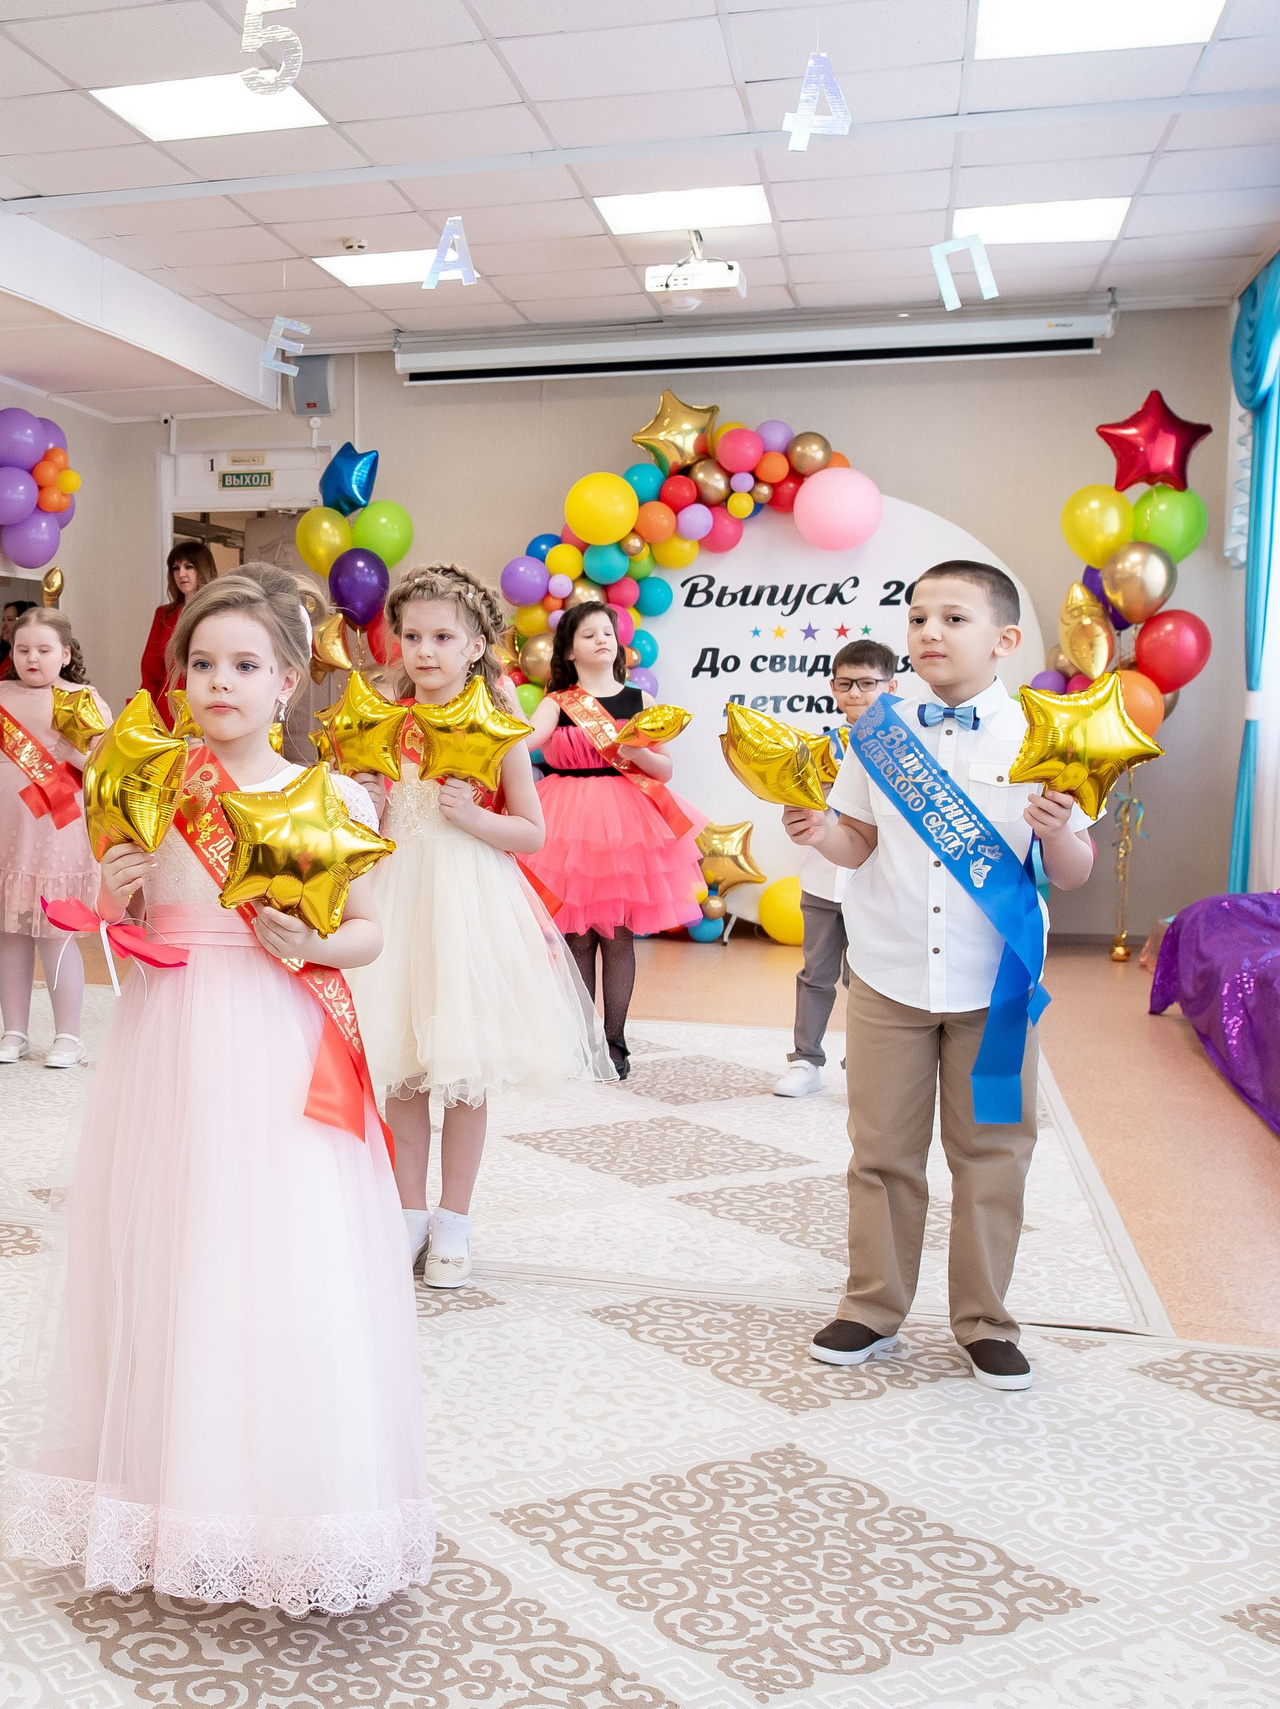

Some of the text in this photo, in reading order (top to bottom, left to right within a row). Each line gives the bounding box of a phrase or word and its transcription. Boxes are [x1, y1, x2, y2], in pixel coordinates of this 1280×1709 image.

[240, 0, 302, 95] 5
[929, 234, 1000, 311] П
[224, 474, 270, 487] ВЫХОД
[680, 574, 860, 617] Выпуск
[691, 647, 741, 678] До
[860, 739, 966, 860] ДЕТСКОГО САДА
[876, 725, 986, 856] Выпускник
